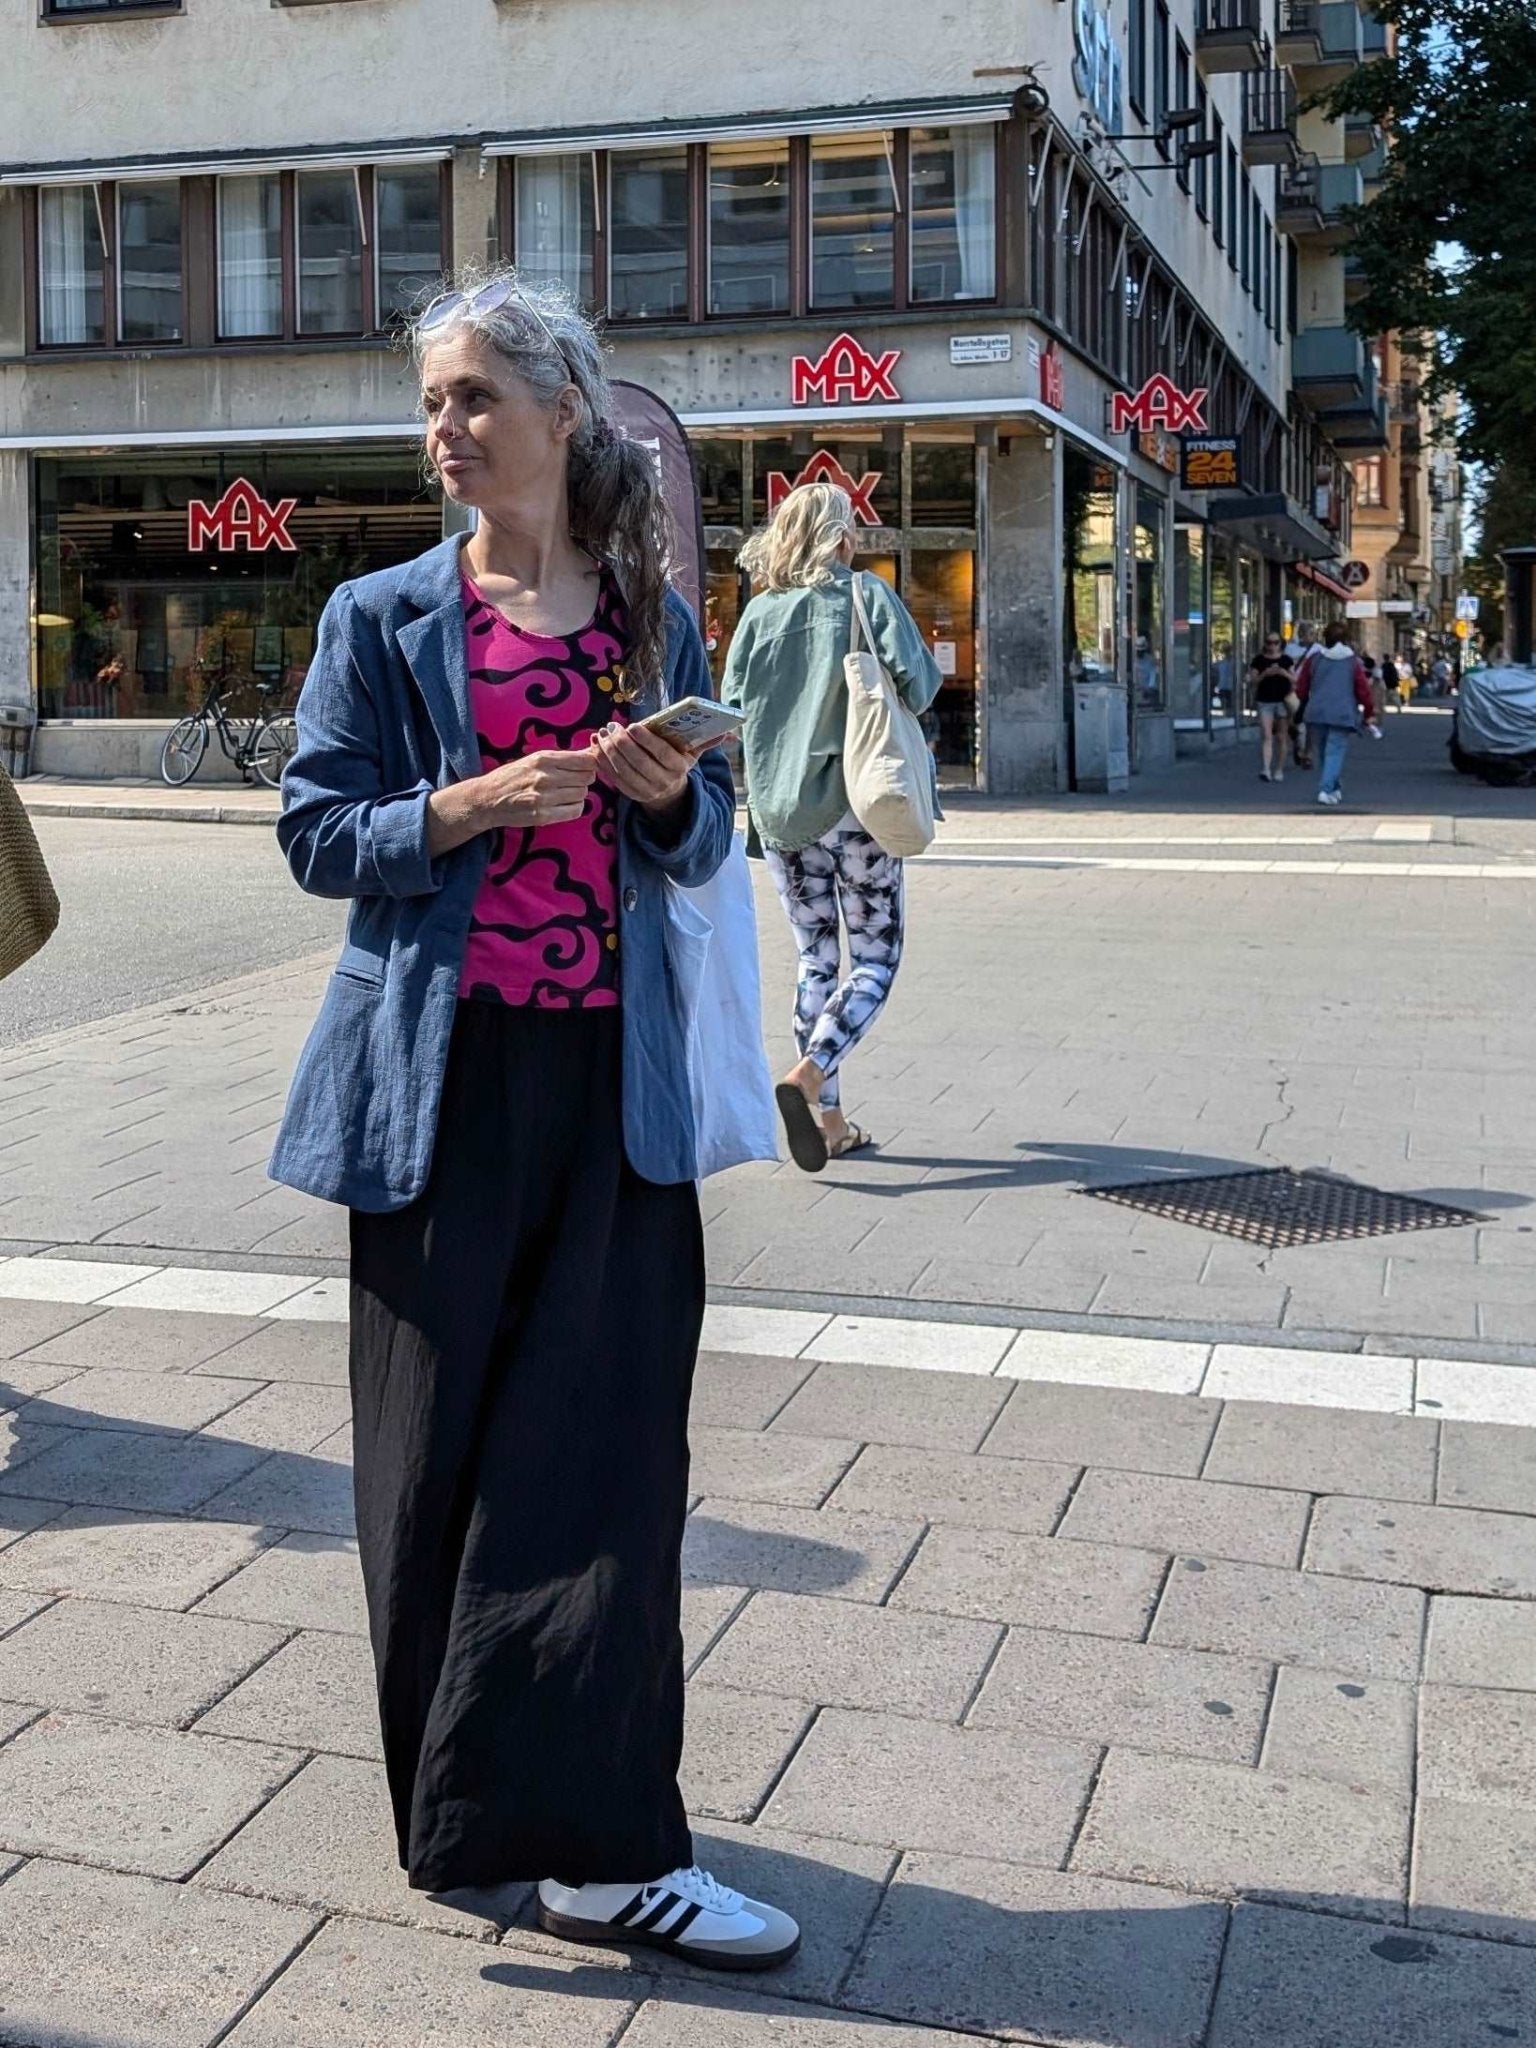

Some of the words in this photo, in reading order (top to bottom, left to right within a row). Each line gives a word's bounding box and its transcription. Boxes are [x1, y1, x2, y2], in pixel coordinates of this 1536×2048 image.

[792, 333, 901, 404] MAX
[1112, 372, 1208, 433] MAX
[1186, 440, 1236, 451] FITNESS
[1187, 451, 1236, 472] 24
[1186, 471, 1236, 484] SEVEN
[188, 477, 297, 551] MAX
